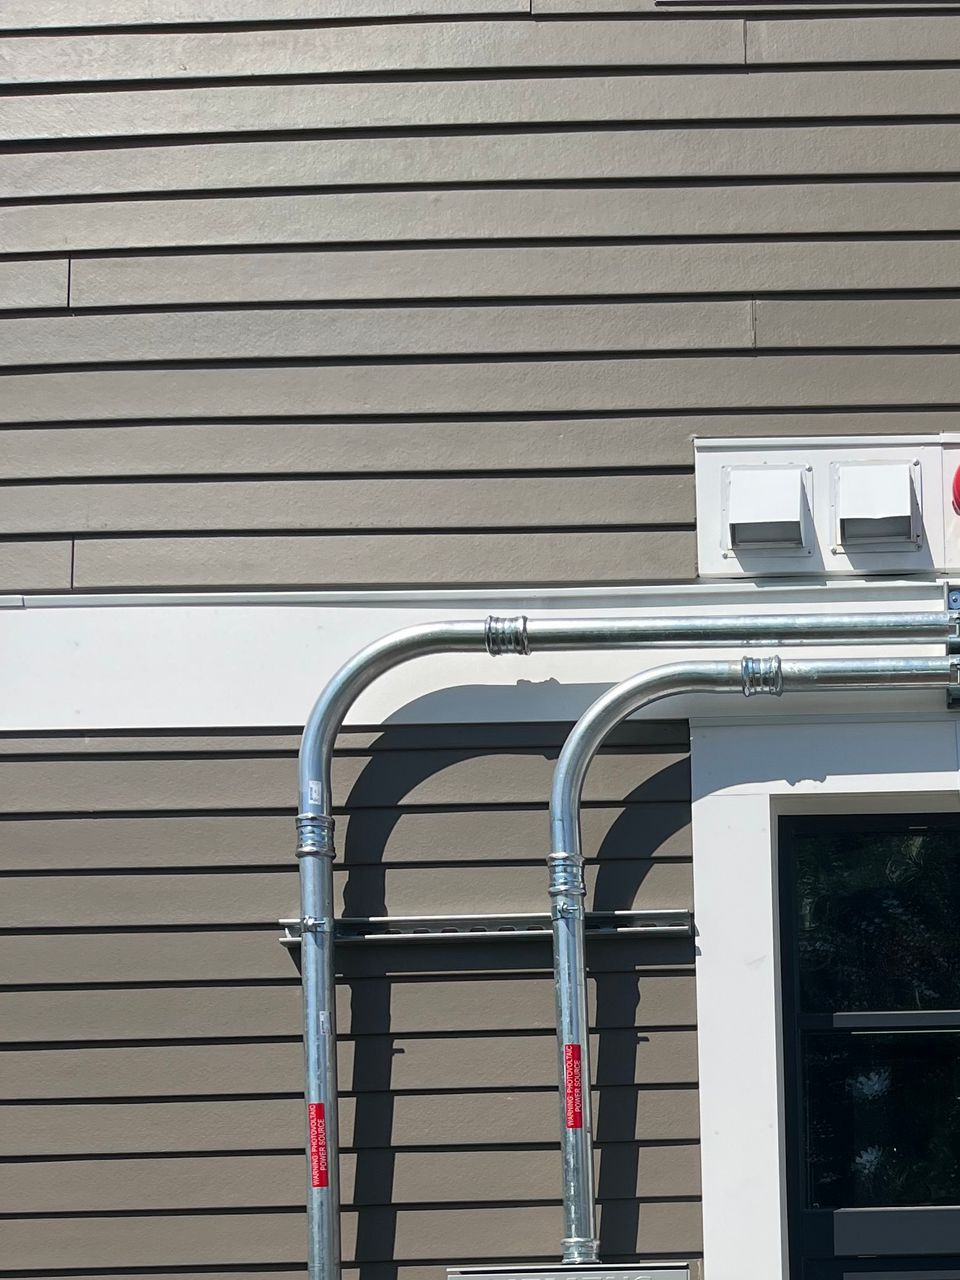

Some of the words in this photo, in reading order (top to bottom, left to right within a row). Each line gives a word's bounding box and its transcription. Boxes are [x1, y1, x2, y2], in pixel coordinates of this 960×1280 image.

[566, 1045, 574, 1094] PHOTOVOLTAIC
[309, 1104, 318, 1153] PHOTOVOLTAIC
[318, 1118, 326, 1145] SOURCE
[319, 1146, 327, 1171] POWER
